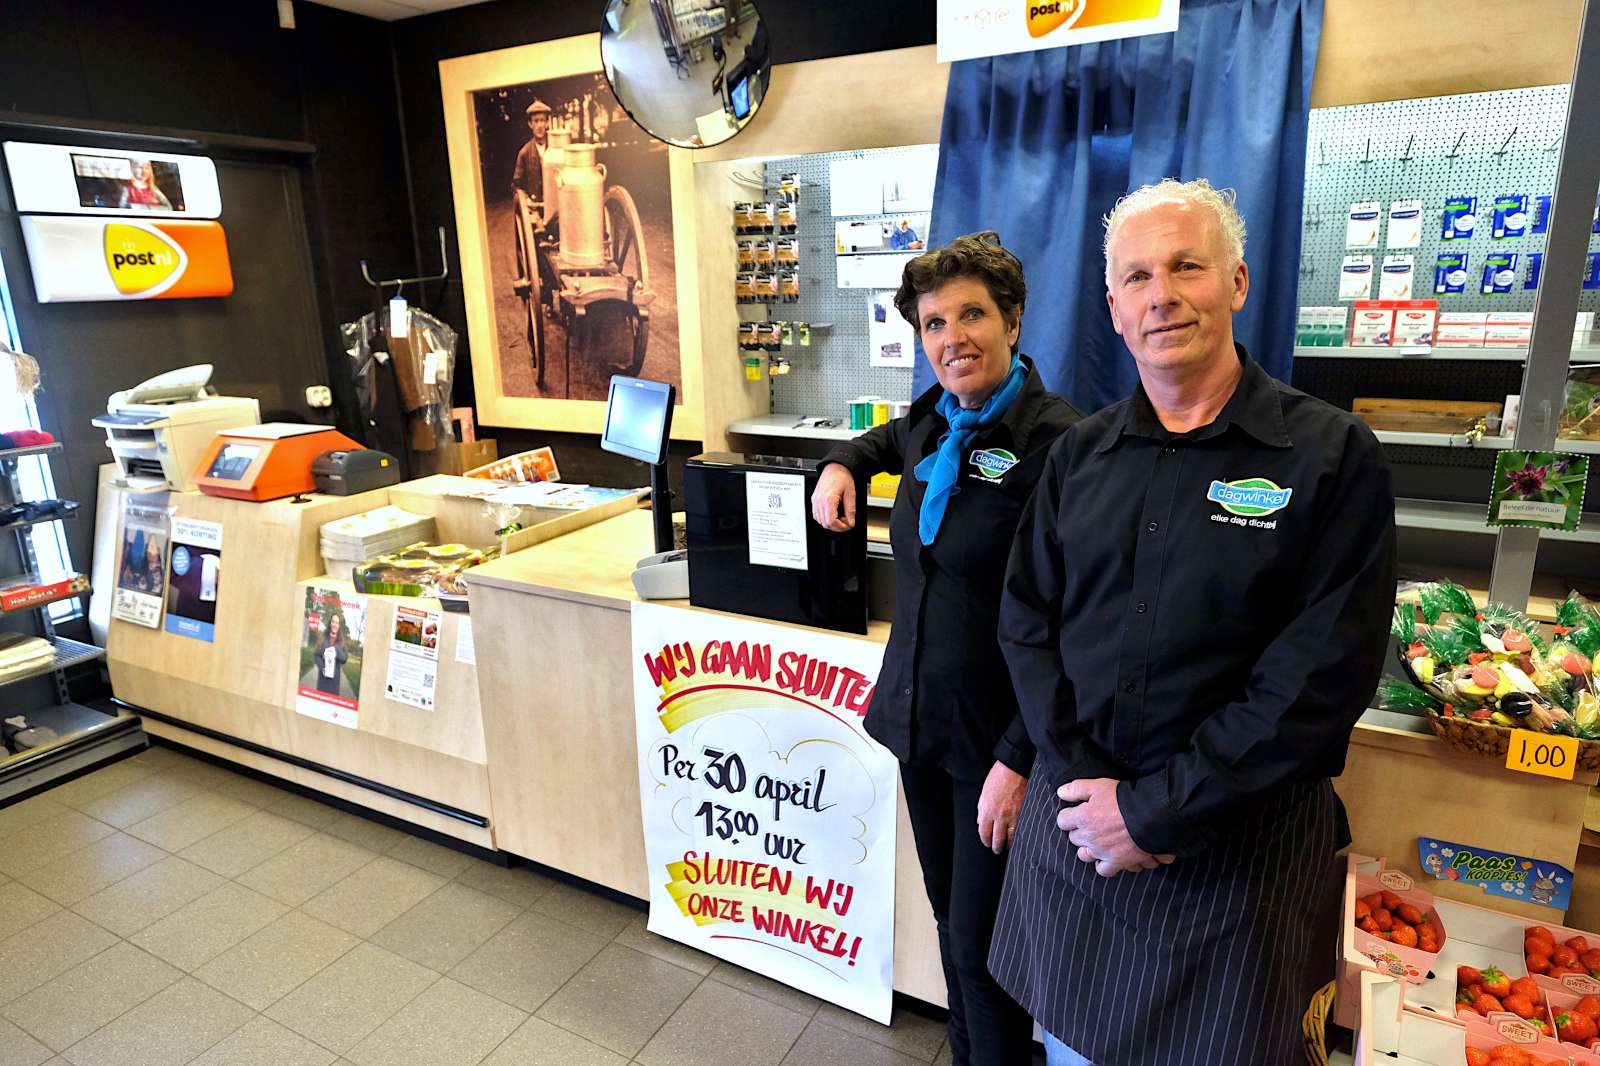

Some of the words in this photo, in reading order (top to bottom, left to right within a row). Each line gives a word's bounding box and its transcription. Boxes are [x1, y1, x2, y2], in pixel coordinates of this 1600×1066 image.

[113, 251, 172, 270] postnl
[1217, 487, 1285, 505] dagwinkel
[1210, 514, 1229, 523] elke
[1230, 516, 1247, 526] dag
[700, 639, 772, 683] GAAN
[1519, 739, 1566, 768] 1,00
[658, 744, 699, 781] Per
[703, 747, 747, 794] 30
[754, 768, 837, 822] april
[1451, 850, 1517, 871] Paas
[683, 850, 793, 896] SLUITEN
[1465, 868, 1529, 882] KOOPJES!
[688, 892, 745, 923] ONZE
[752, 905, 863, 967] WINKEL!
[1501, 1025, 1535, 1040] SWEET
